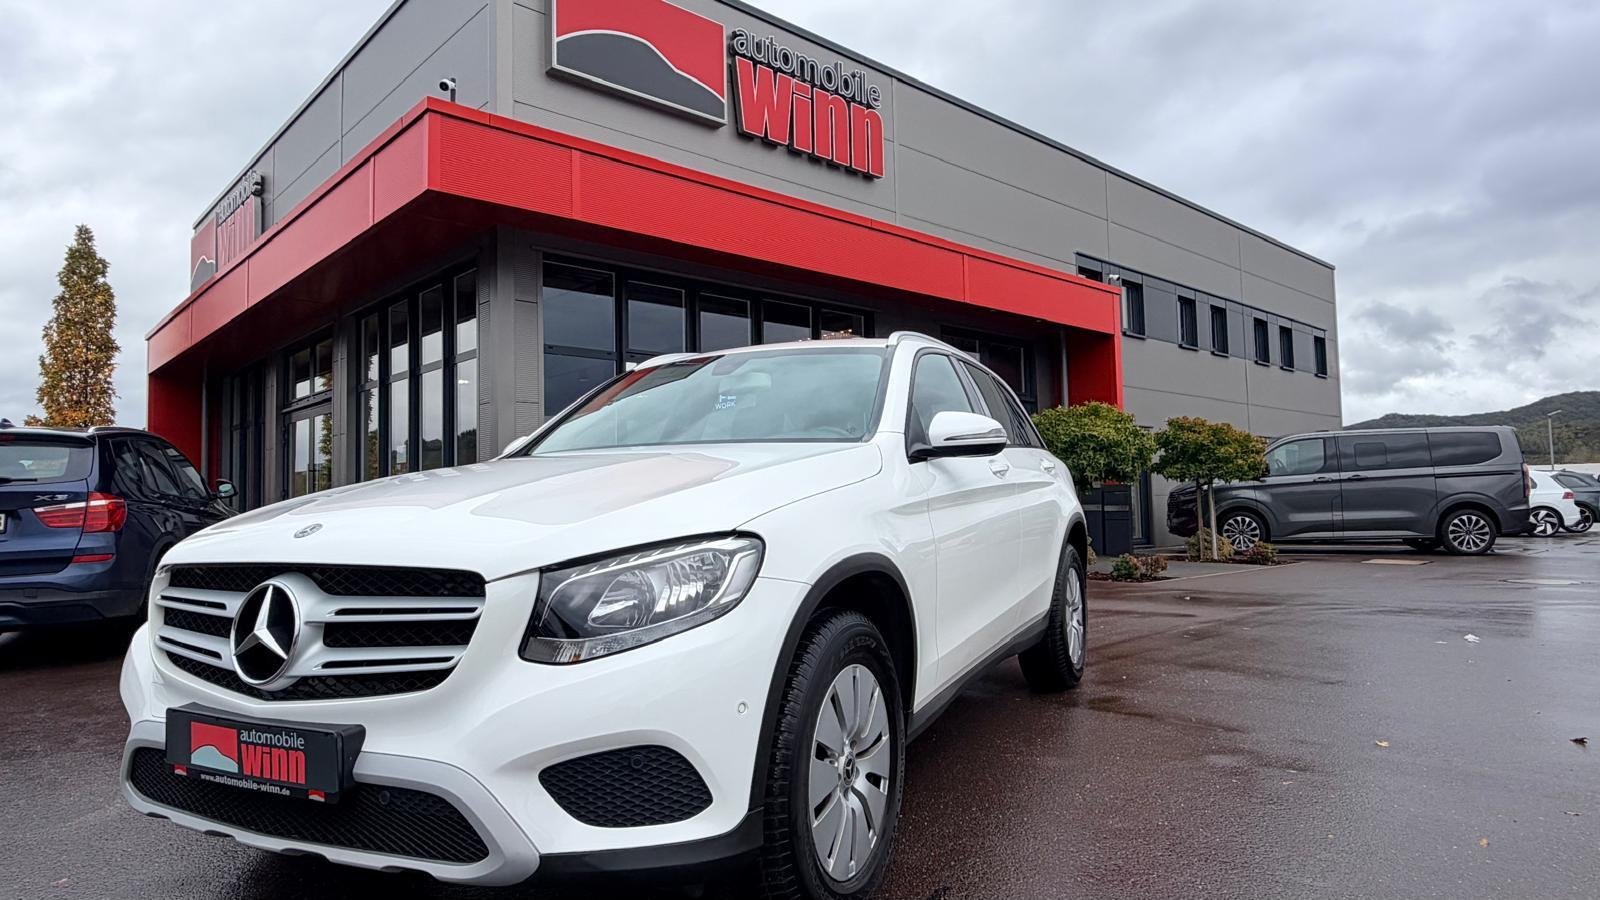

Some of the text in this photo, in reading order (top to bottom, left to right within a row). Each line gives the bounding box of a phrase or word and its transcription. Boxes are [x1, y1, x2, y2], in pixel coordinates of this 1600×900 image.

[734, 28, 881, 108] automobile
[33, 494, 68, 502] X3
[239, 729, 305, 750] automobile
[200, 773, 291, 796] www.automobile-winn.de
